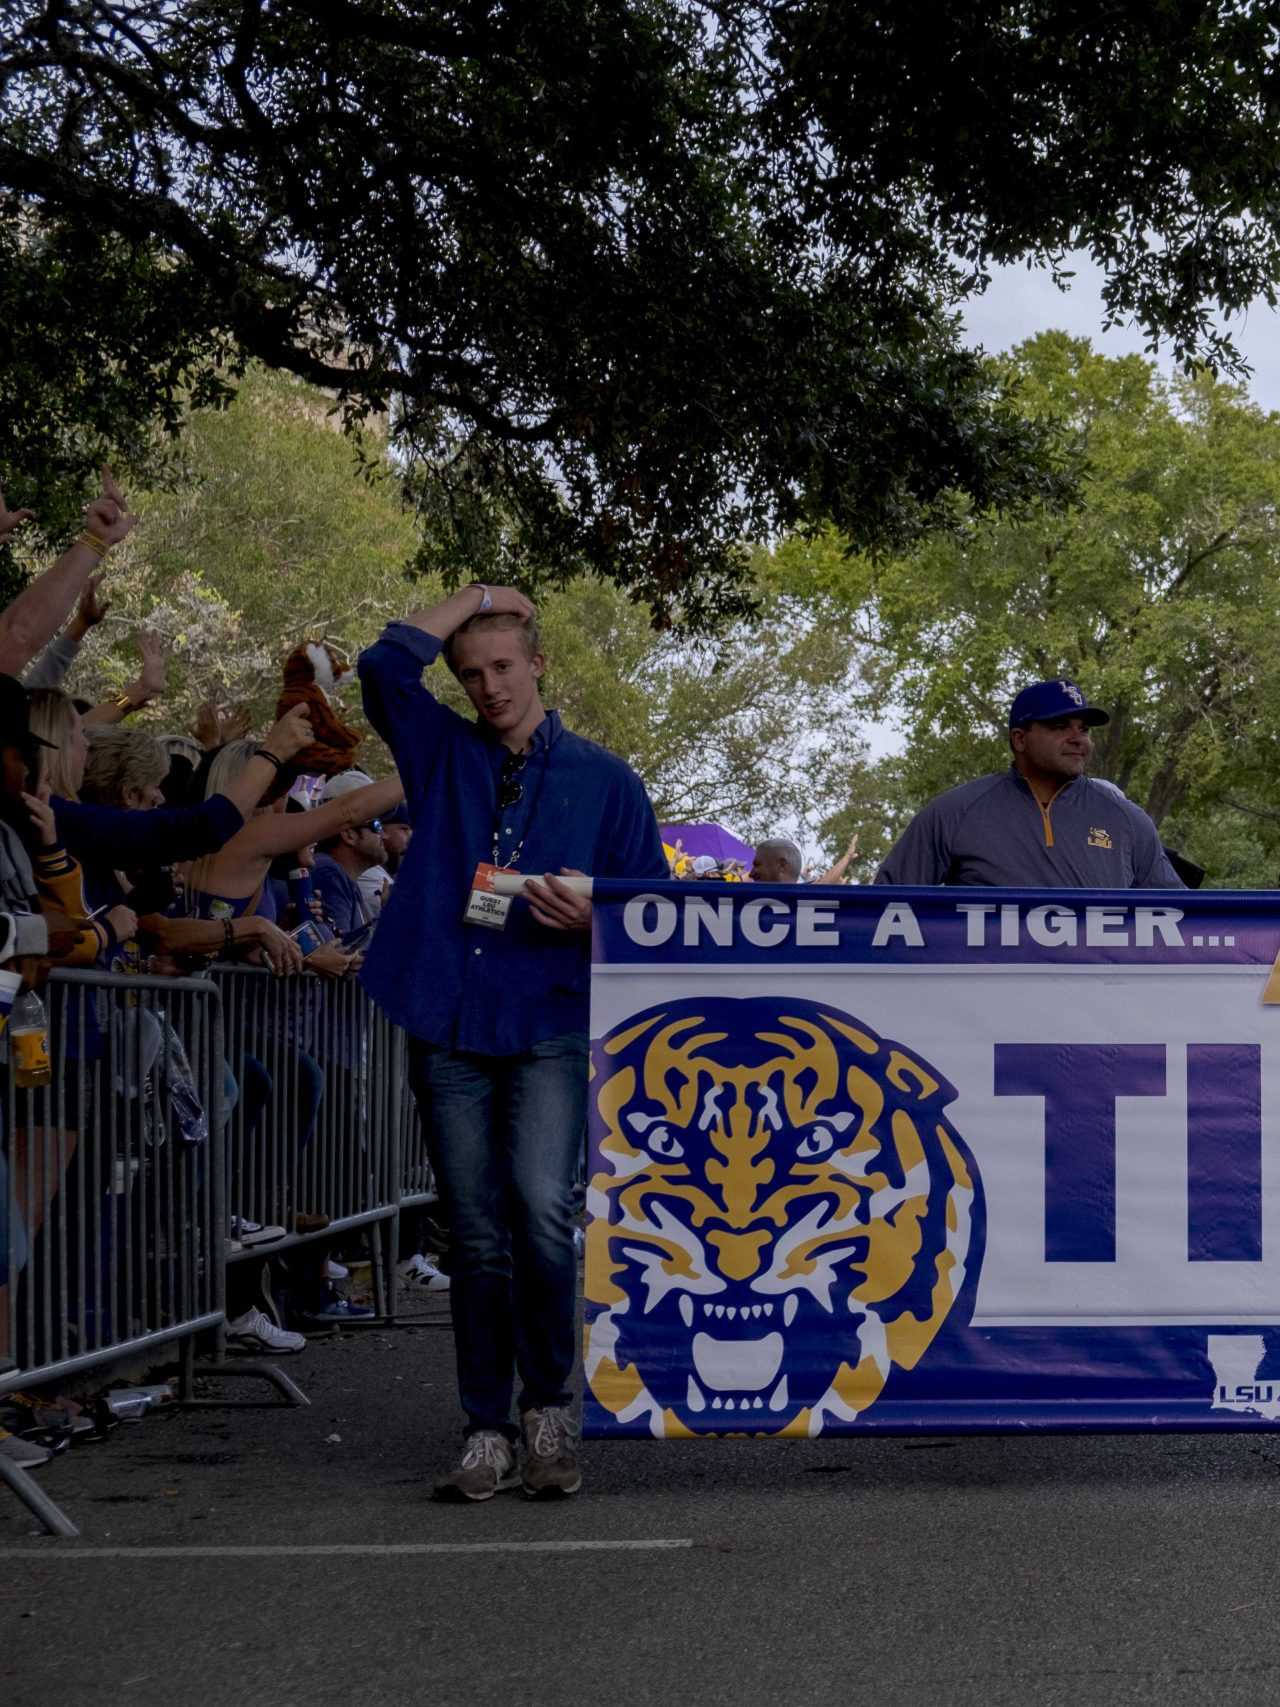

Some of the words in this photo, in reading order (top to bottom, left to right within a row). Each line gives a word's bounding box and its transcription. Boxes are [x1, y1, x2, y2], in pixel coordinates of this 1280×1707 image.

[622, 893, 840, 947] ONCE
[872, 900, 926, 947] A
[955, 903, 1236, 947] TIGER...
[1219, 1385, 1273, 1403] LSU
